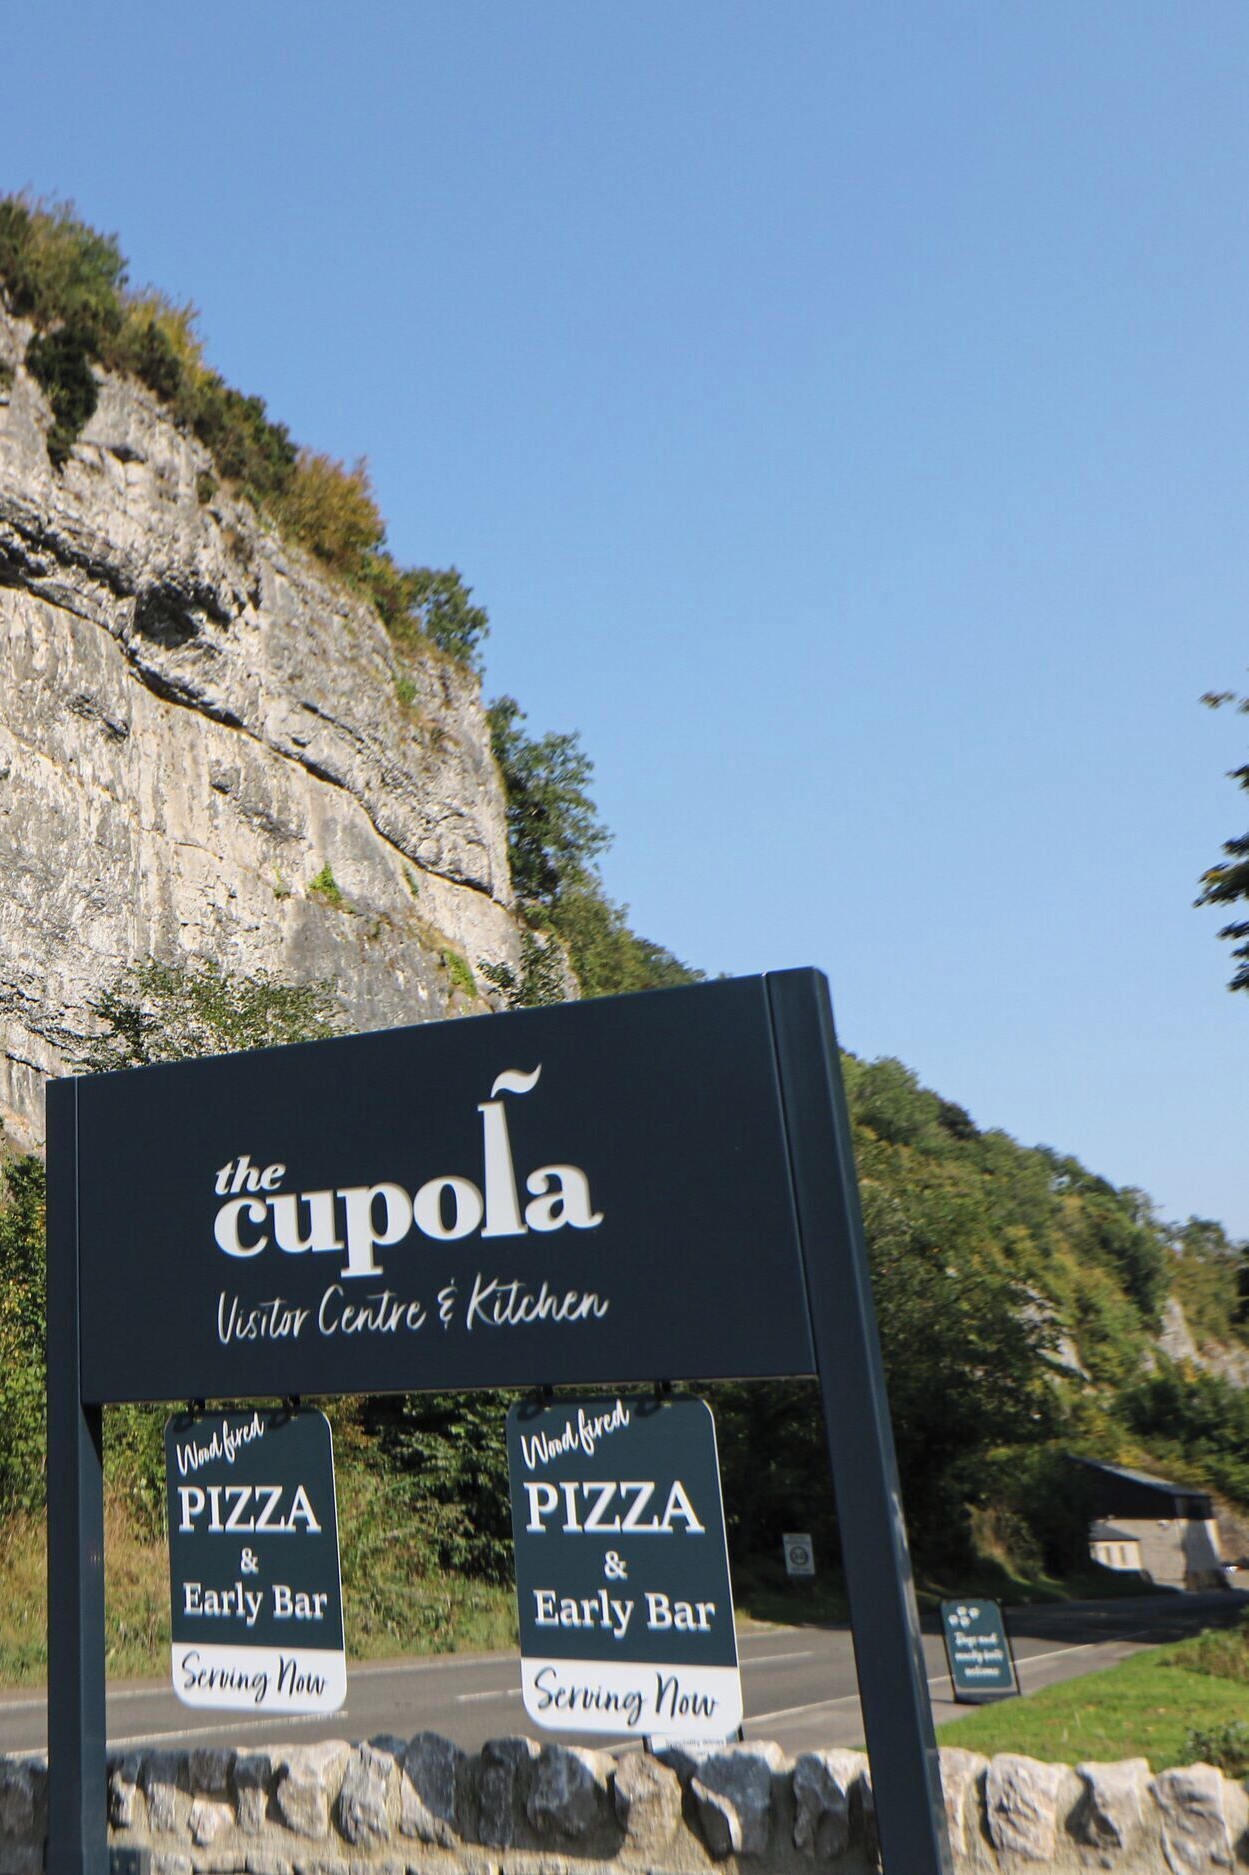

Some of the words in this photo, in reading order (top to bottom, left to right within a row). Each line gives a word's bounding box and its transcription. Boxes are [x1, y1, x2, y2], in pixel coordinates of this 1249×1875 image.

[213, 1099, 604, 1278] cupola
[214, 1154, 287, 1196] the
[216, 1289, 311, 1344] Visitor
[317, 1284, 428, 1335] Centre
[437, 1276, 458, 1331] &
[465, 1271, 611, 1331] Kitchen
[177, 1484, 322, 1534] PIZZA
[523, 1480, 706, 1534] PIZZA
[240, 1547, 259, 1575] &
[603, 1550, 629, 1581] &
[182, 1581, 264, 1628] Early
[271, 1584, 328, 1621] Bar
[532, 1588, 635, 1640] Early
[644, 1592, 717, 1633] Bar
[181, 1650, 269, 1703] Serving
[277, 1653, 327, 1697] Now
[533, 1666, 646, 1728] Serving
[654, 1670, 719, 1720] Now
